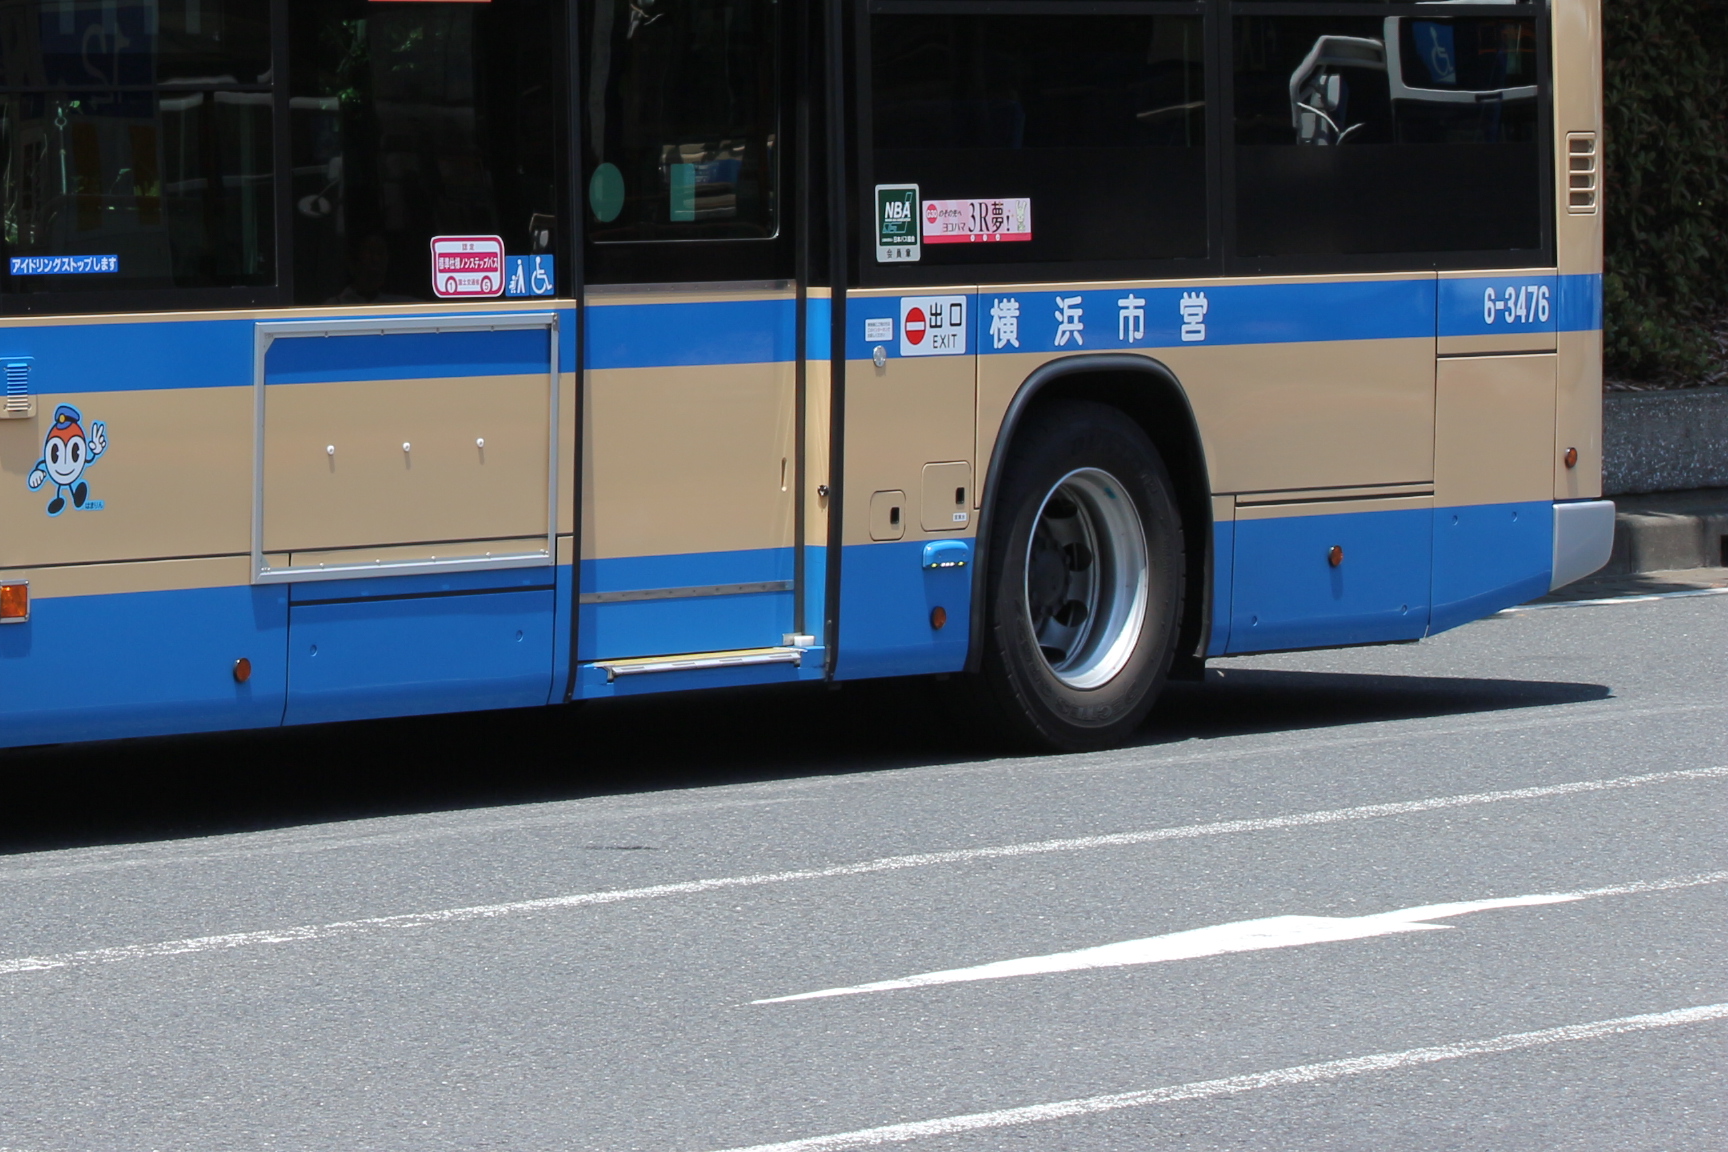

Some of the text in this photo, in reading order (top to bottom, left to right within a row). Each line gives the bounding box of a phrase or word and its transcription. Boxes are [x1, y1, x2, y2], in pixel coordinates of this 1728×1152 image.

[884, 201, 911, 218] NBA
[943, 222, 966, 233] ヨコハマ
[12, 257, 117, 274] アイドリングストップします
[1483, 285, 1550, 325] 6-3476
[929, 302, 962, 329] 出口
[990, 291, 1209, 349] 横浜市営
[932, 334, 957, 349] EXIT
